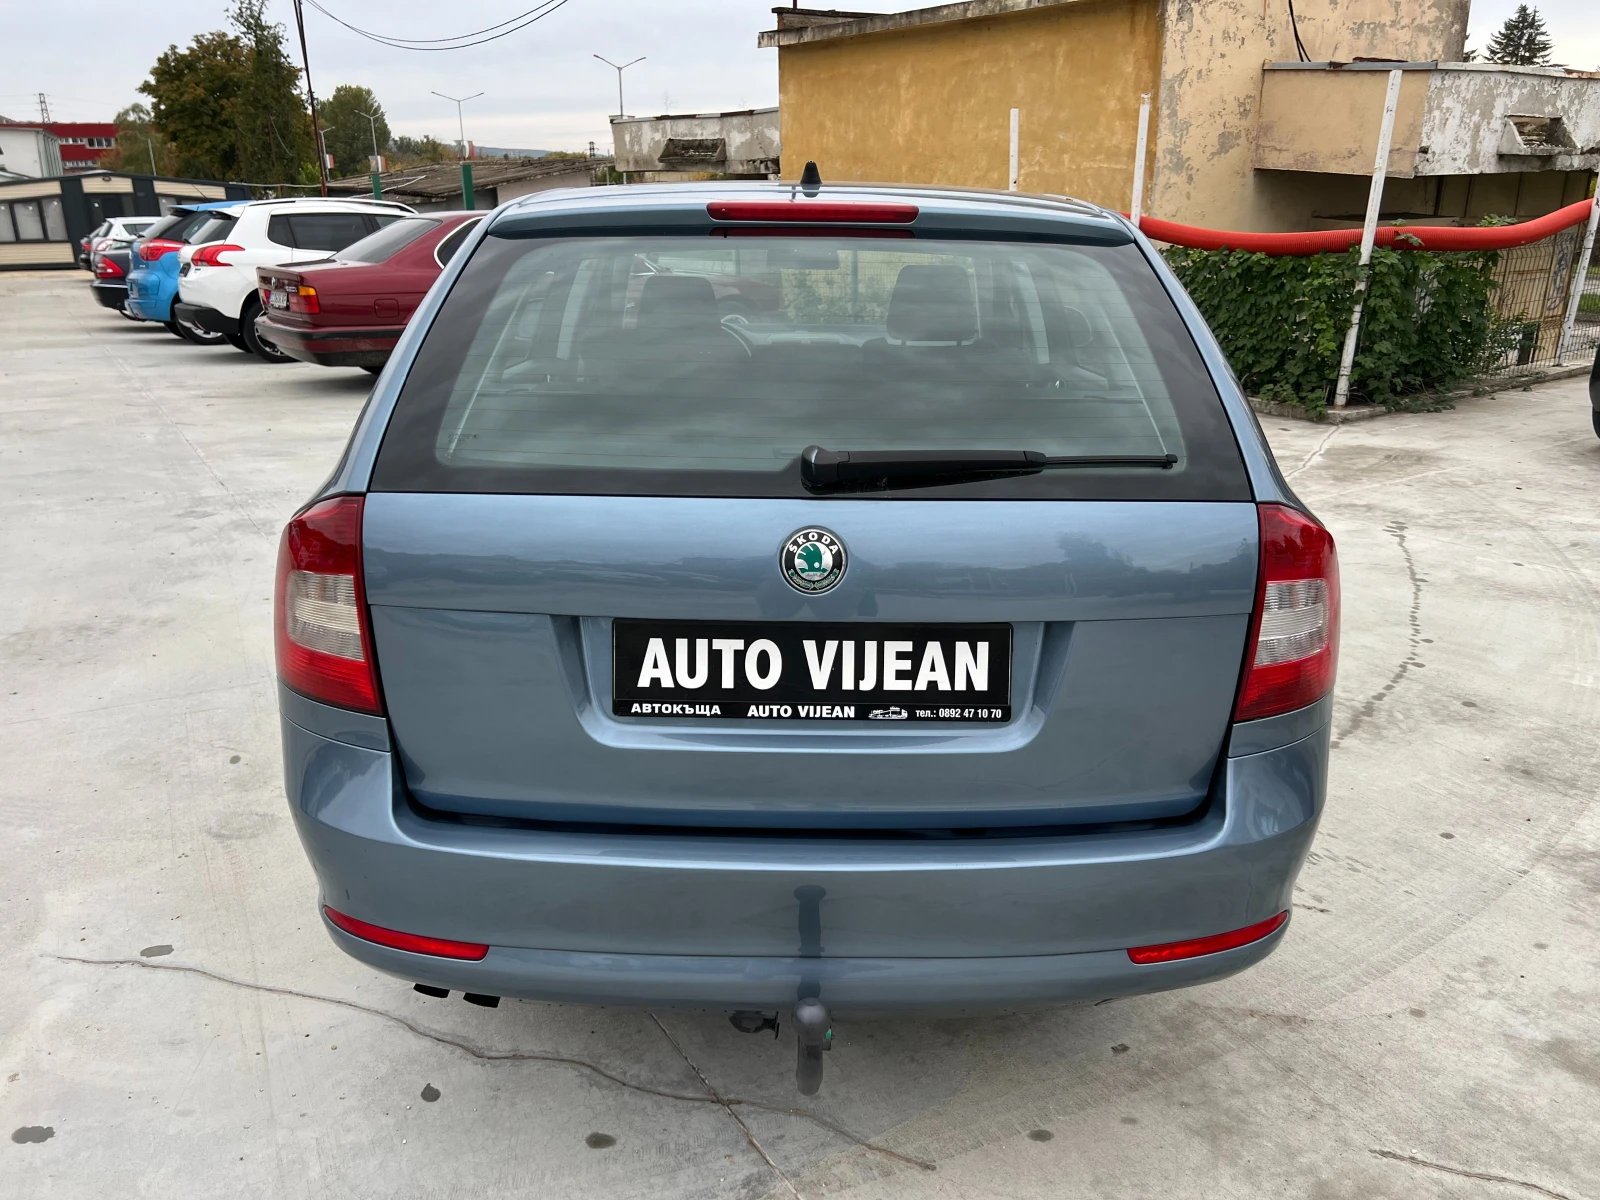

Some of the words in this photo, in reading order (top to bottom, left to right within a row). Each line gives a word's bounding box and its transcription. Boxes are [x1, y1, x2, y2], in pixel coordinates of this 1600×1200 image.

[637, 638, 782, 690] AUTO
[803, 640, 989, 691] VIJEAN
[631, 703, 722, 716] АВТОКЪЩА
[747, 705, 792, 718] AUTO
[798, 705, 855, 718] VIJEAN
[938, 708, 961, 718] 0892
[963, 709, 974, 718] 47
[977, 709, 988, 718] 10
[990, 709, 1002, 718] 70
